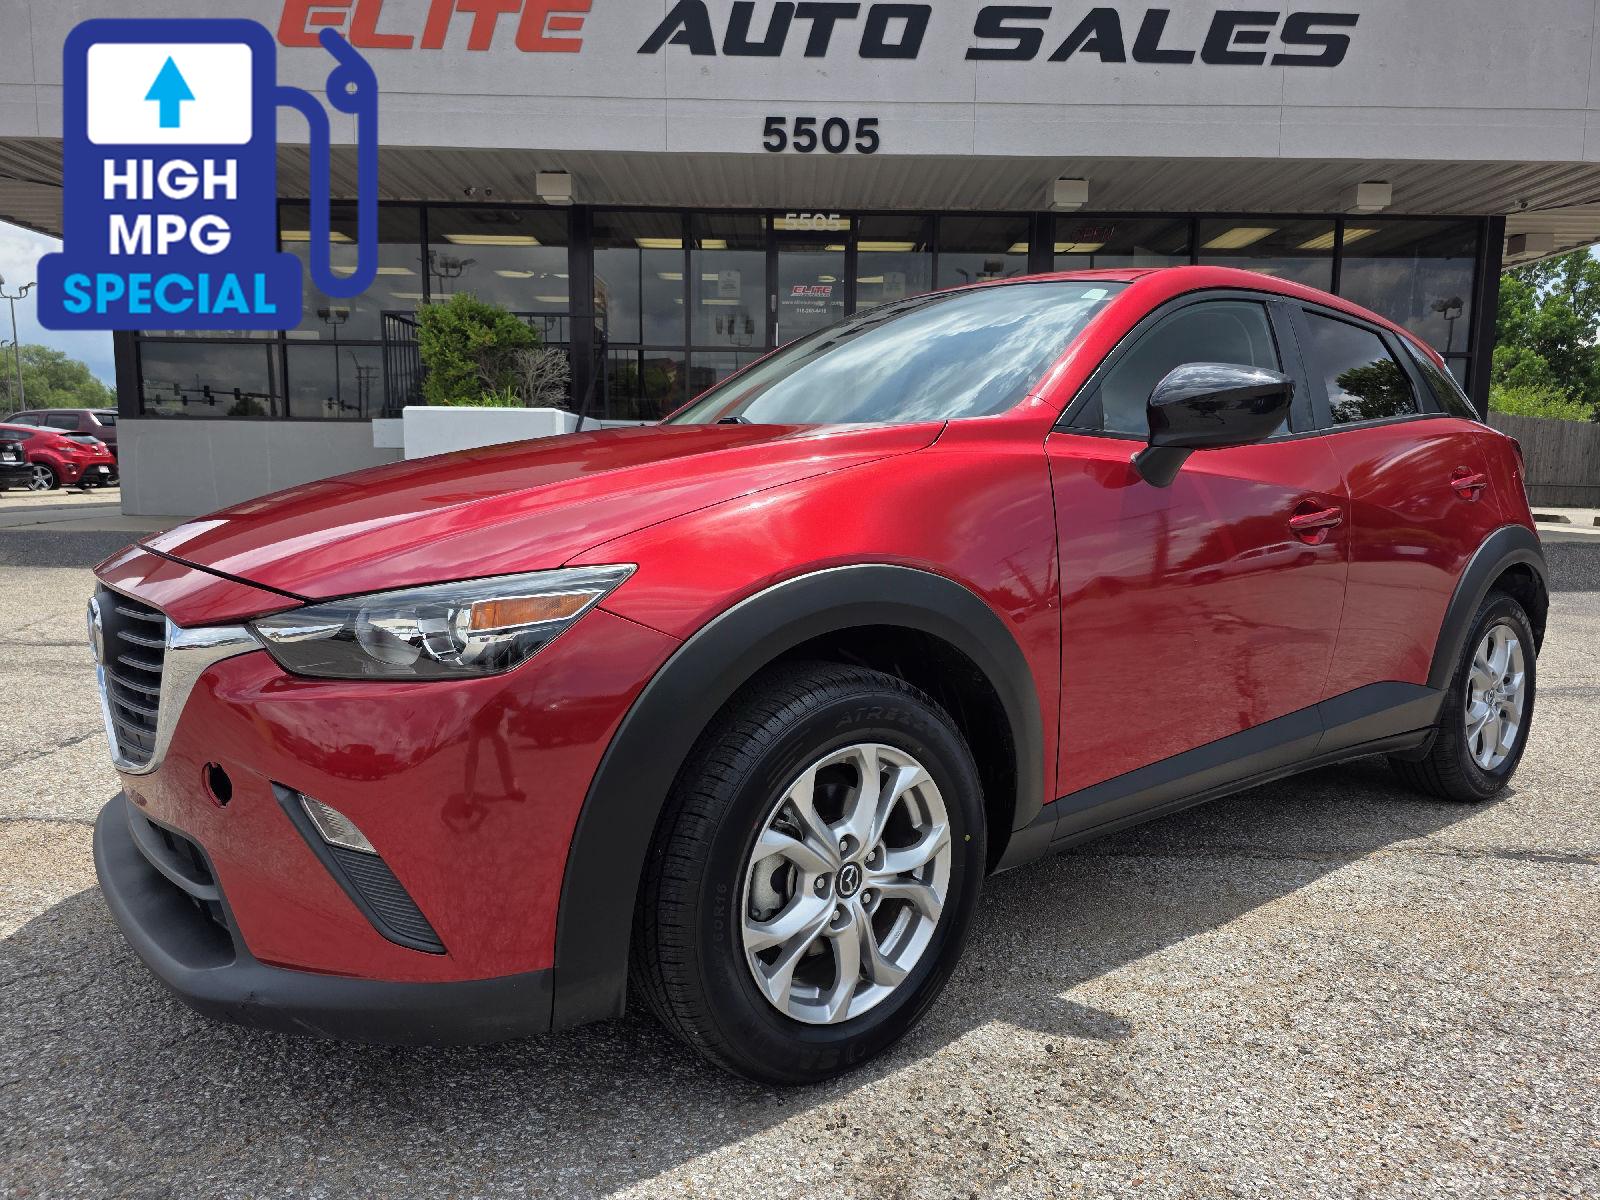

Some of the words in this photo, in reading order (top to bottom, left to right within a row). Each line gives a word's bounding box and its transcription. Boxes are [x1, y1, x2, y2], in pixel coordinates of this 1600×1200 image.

[277, 0, 592, 53] ELITE
[636, 0, 932, 59] AUTO
[964, 5, 1360, 67] SALES
[763, 116, 880, 154] 5505
[785, 213, 841, 231] 5505
[792, 285, 832, 294] ELITE
